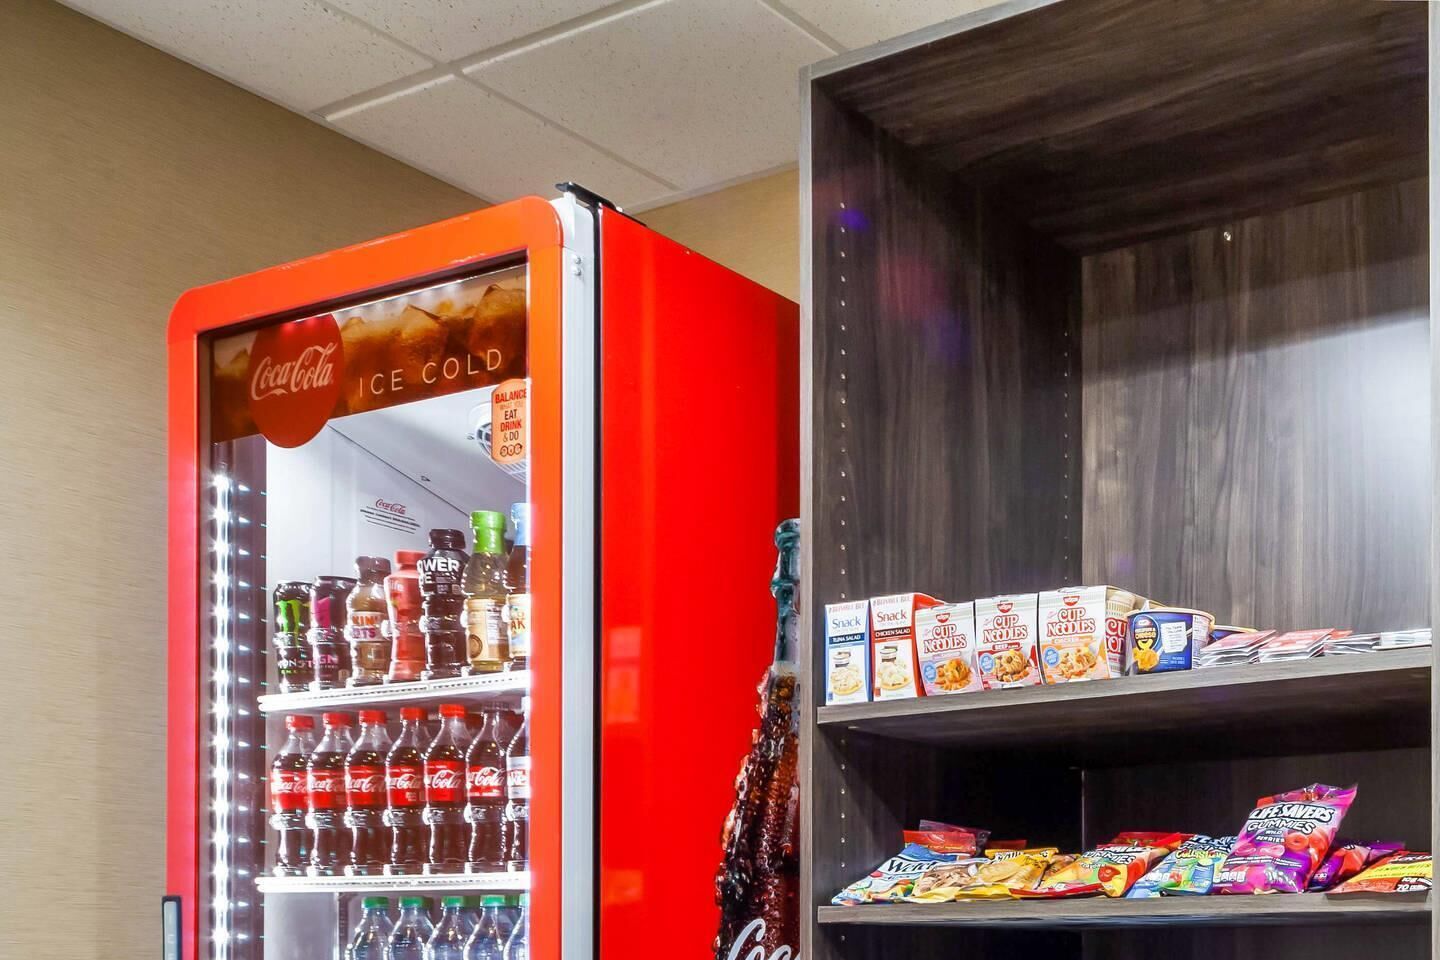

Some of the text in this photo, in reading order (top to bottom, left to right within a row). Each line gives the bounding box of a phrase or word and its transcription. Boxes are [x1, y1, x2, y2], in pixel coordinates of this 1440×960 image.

[251, 343, 337, 400] Coca-Cola
[359, 349, 502, 398] ICE COLD
[495, 389, 527, 404] BALANCE
[505, 409, 517, 420] EAT
[501, 420, 522, 432] DRINK
[417, 558, 460, 572] OWER
[876, 610, 907, 623] Snack
[994, 614, 1019, 629] CUP
[1059, 607, 1086, 622] CUP
[832, 617, 862, 628] Snack
[1047, 618, 1096, 637] NOODLES
[932, 624, 956, 638] CUP
[983, 625, 1027, 643] NOODLES
[923, 634, 967, 653] NOODLES
[1247, 819, 1317, 835] GUMMIES
